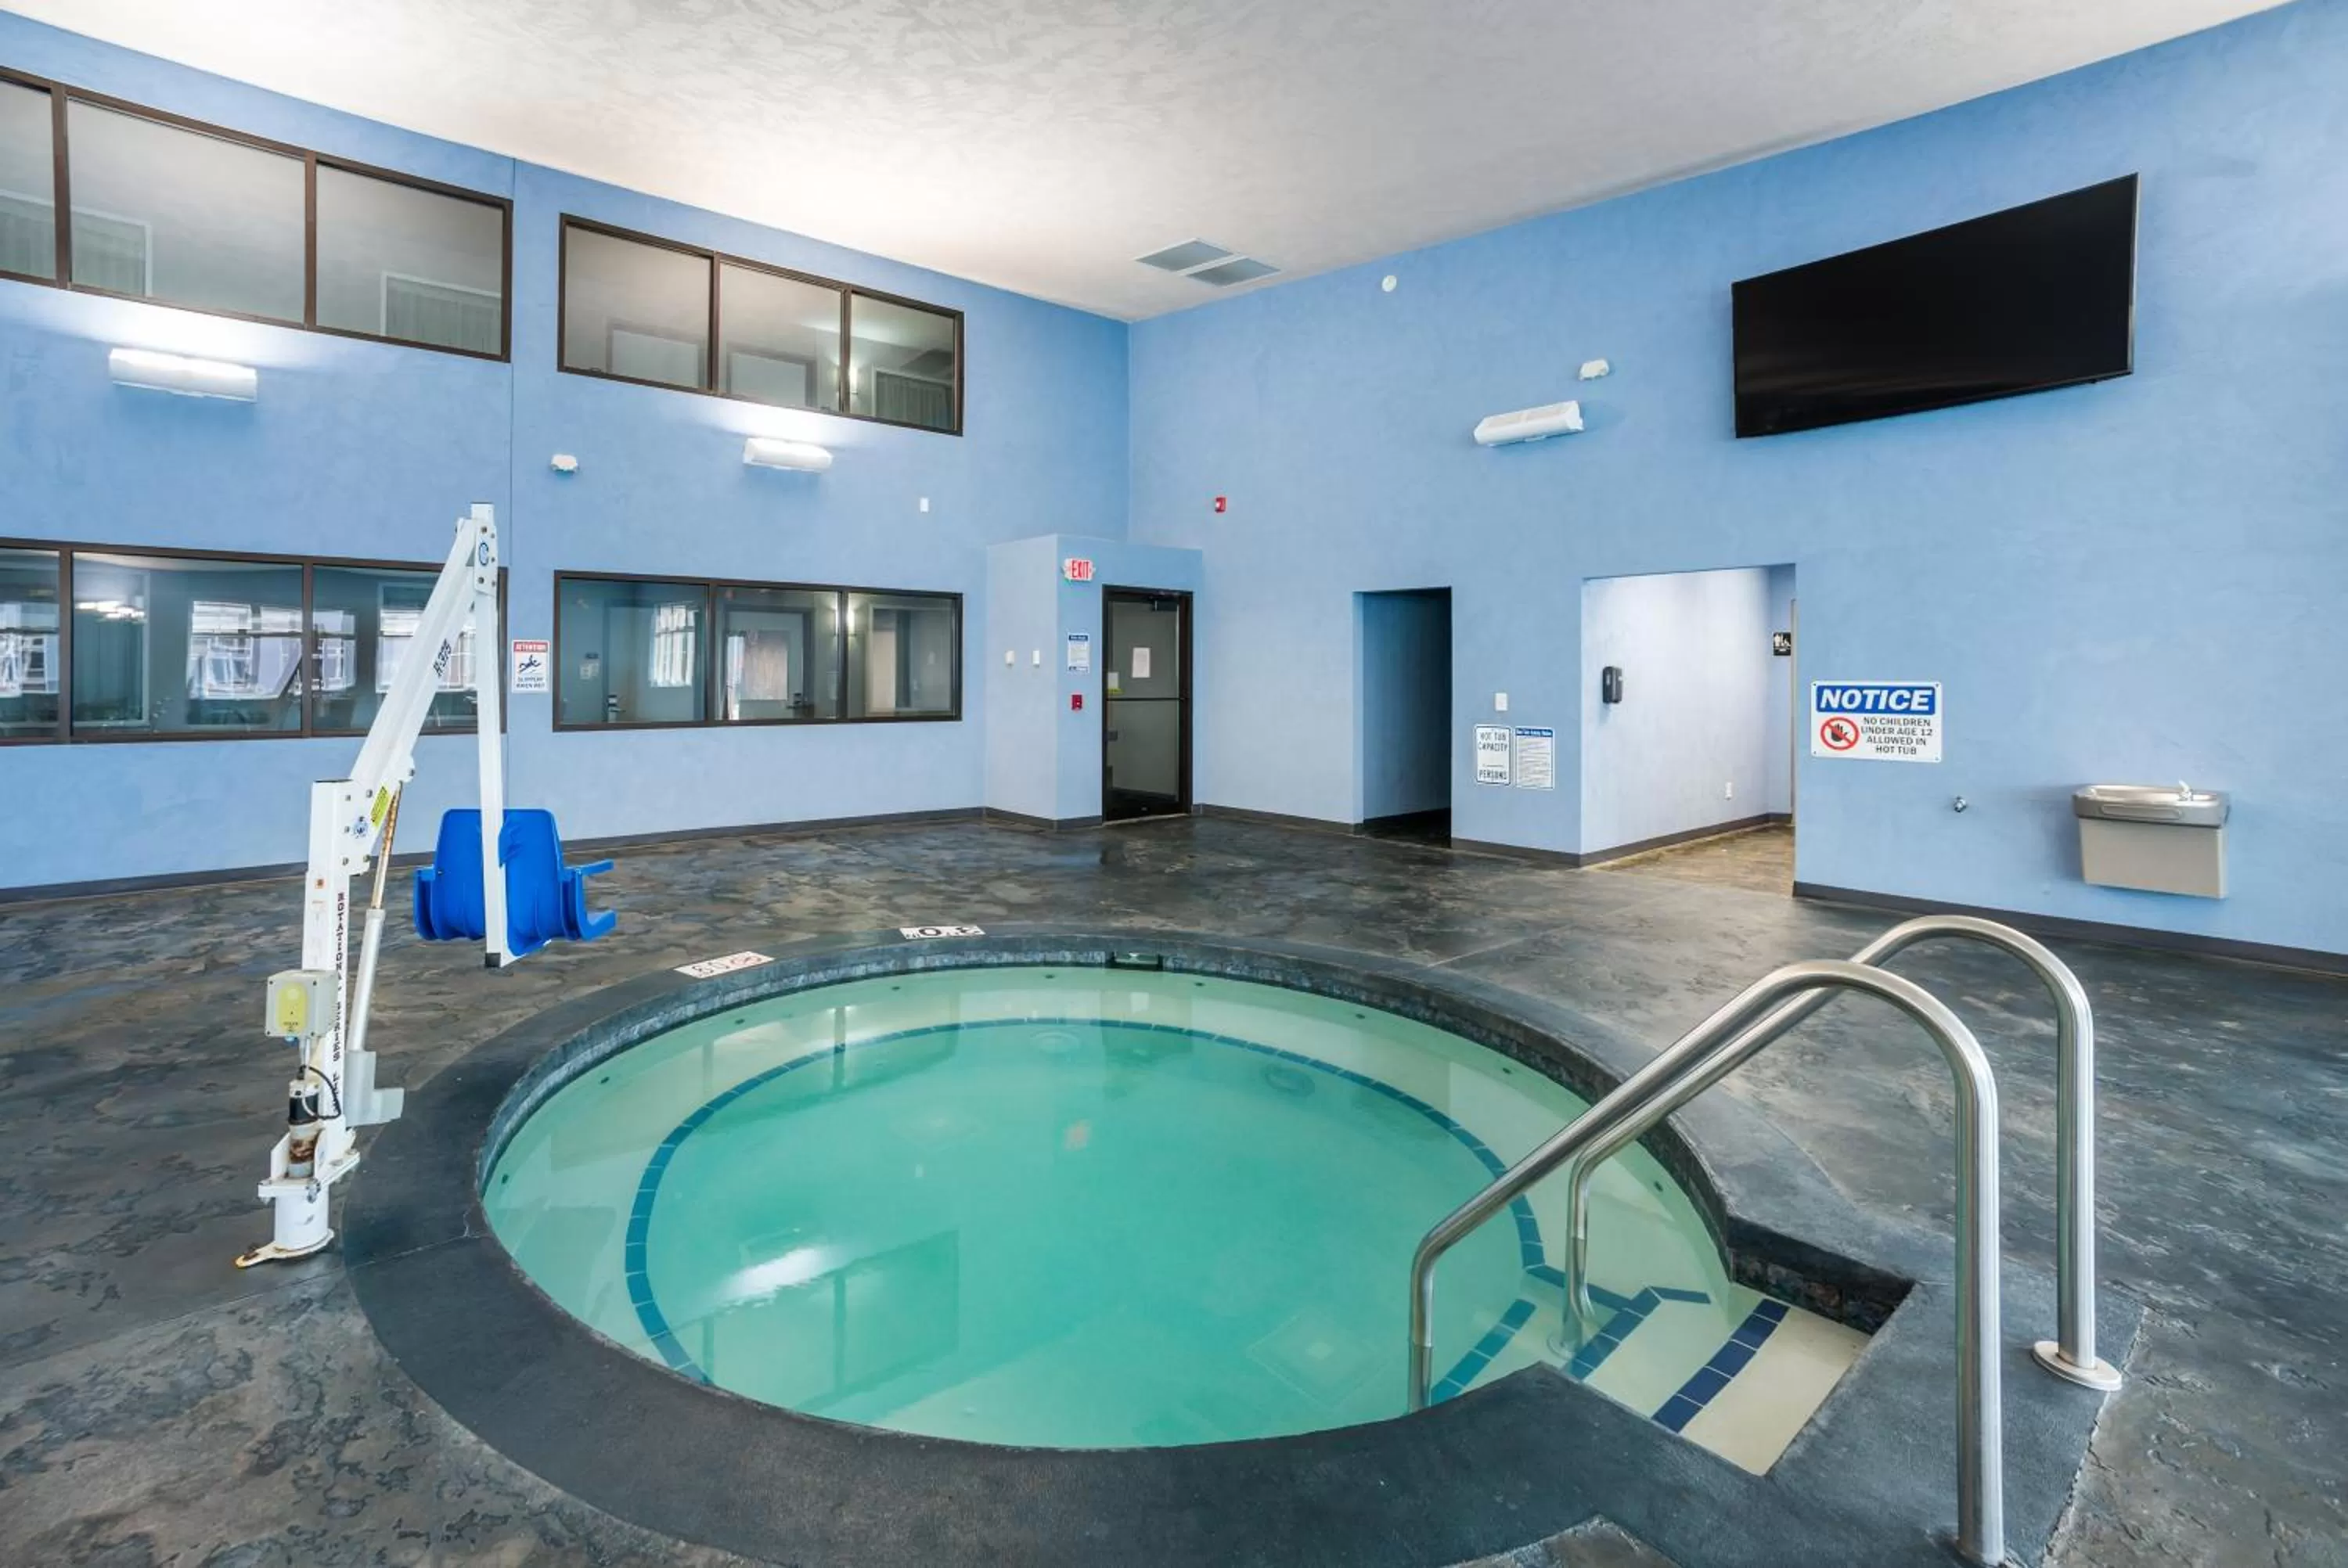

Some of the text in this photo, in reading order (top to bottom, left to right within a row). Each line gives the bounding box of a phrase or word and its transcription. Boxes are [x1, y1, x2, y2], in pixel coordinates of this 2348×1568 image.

[1071, 560, 1089, 579] EXIT
[1820, 689, 1933, 711] NOTICE
[1864, 717, 1931, 727] NO CHILDREN
[1494, 732, 1506, 741] TUB
[1866, 735, 1913, 745] ALLOWED
[1478, 743, 1507, 751] CAPACITY
[1898, 746, 1917, 755] TUB
[1479, 770, 1507, 780] PERSONS
[335, 893, 345, 991] ROTATIONA
